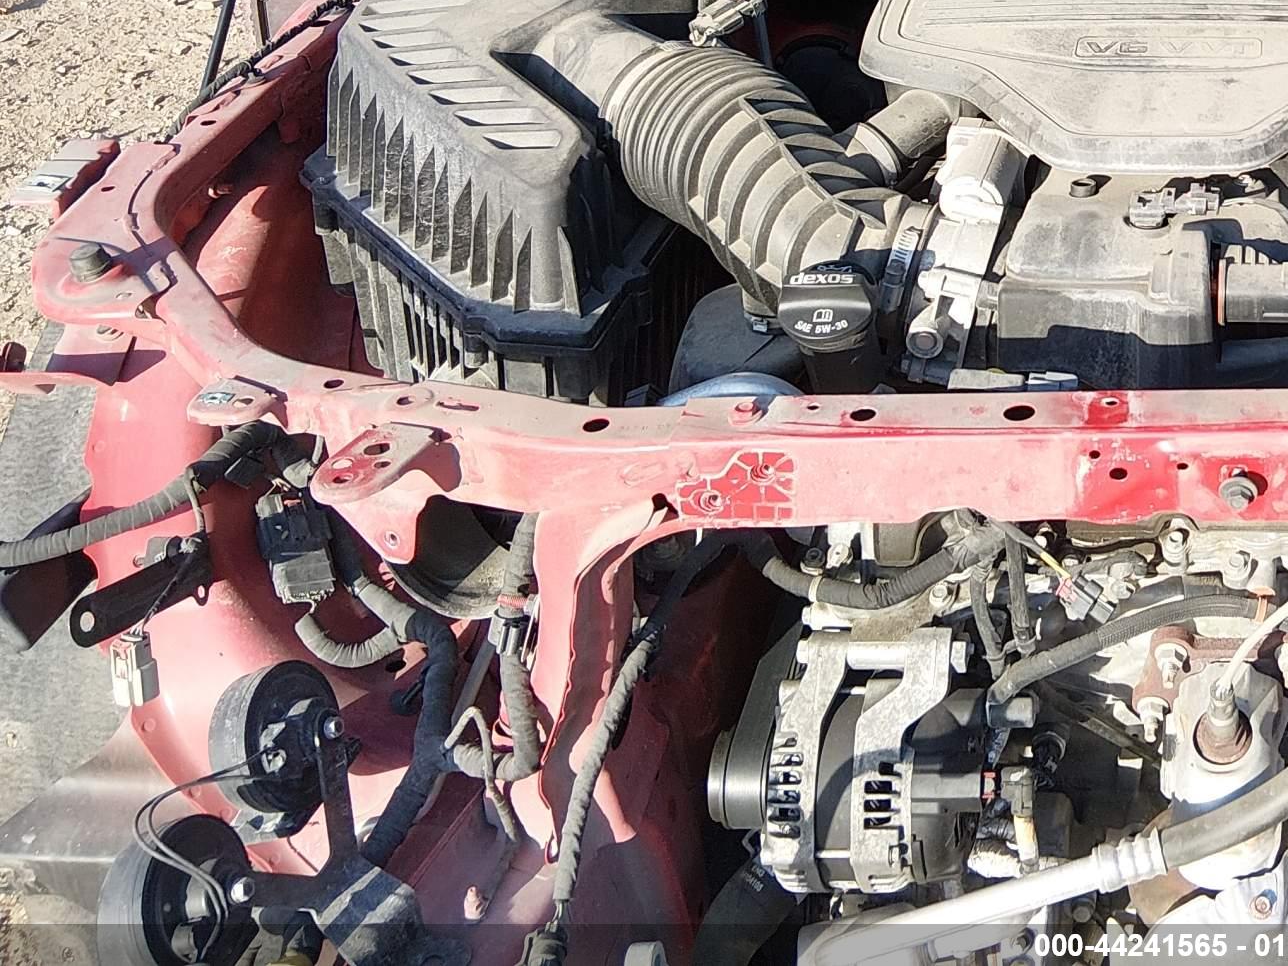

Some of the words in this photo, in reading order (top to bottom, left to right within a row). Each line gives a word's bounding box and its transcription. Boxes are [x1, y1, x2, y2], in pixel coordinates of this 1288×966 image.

[1086, 40, 1148, 54] V6
[1160, 40, 1255, 55] VVT
[789, 272, 855, 285] dexos
[794, 320, 813, 333] SAE
[814, 319, 849, 334] 5W-30
